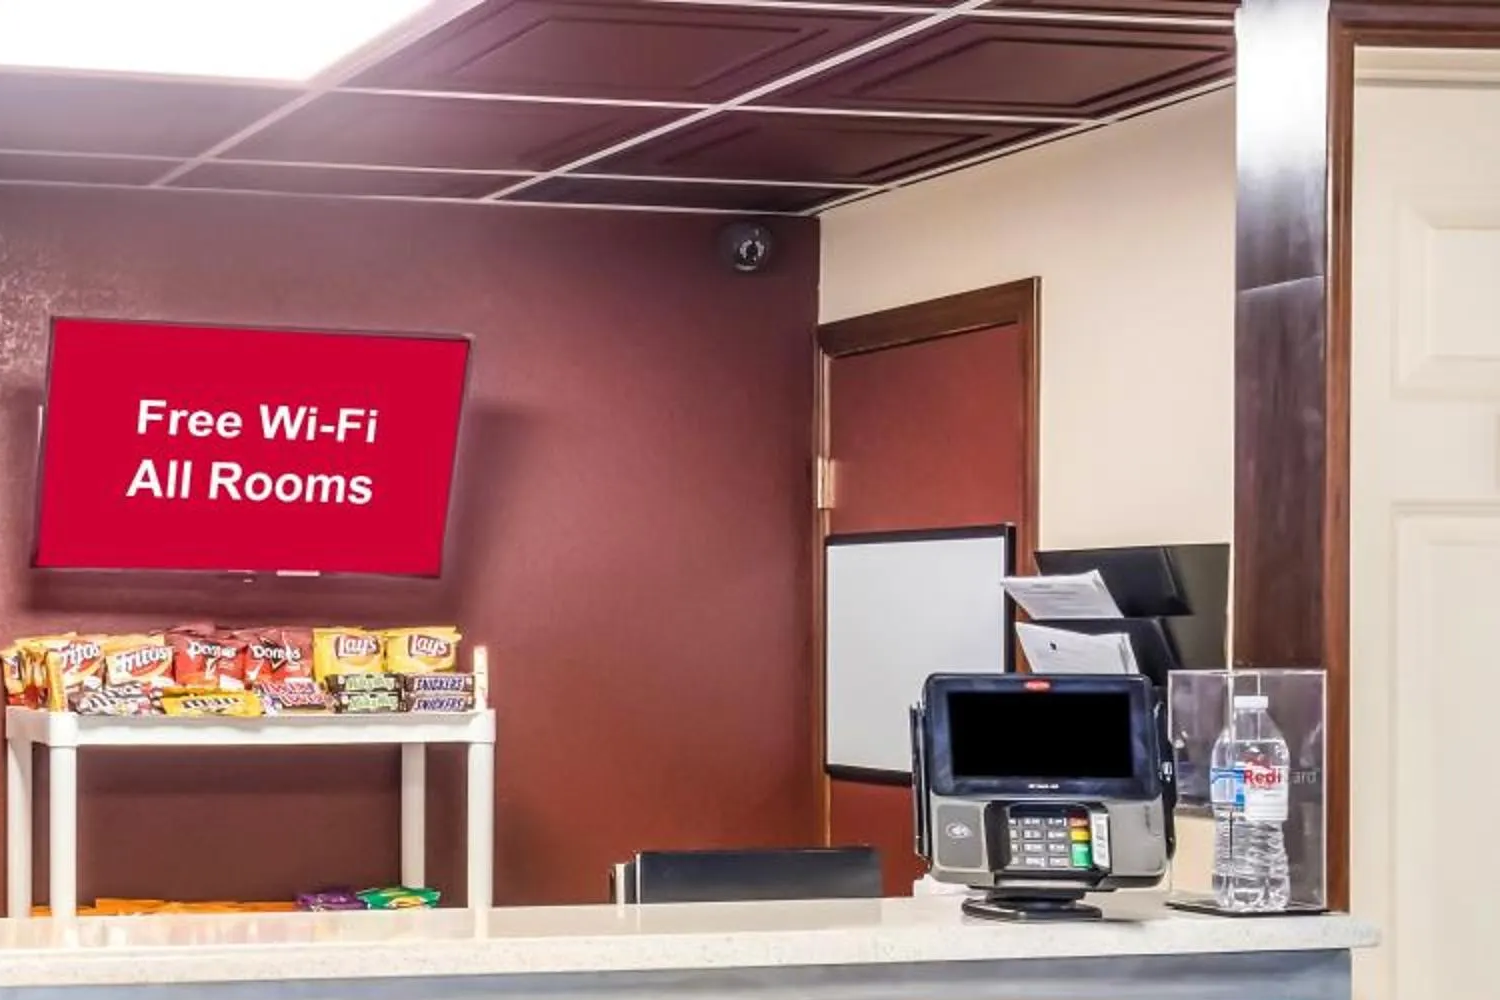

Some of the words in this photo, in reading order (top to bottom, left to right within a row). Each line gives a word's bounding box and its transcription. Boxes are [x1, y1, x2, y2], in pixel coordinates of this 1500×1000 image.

[137, 399, 243, 438] Free
[259, 403, 379, 443] Wi-Fi
[125, 458, 192, 499] All
[208, 461, 373, 505] Rooms
